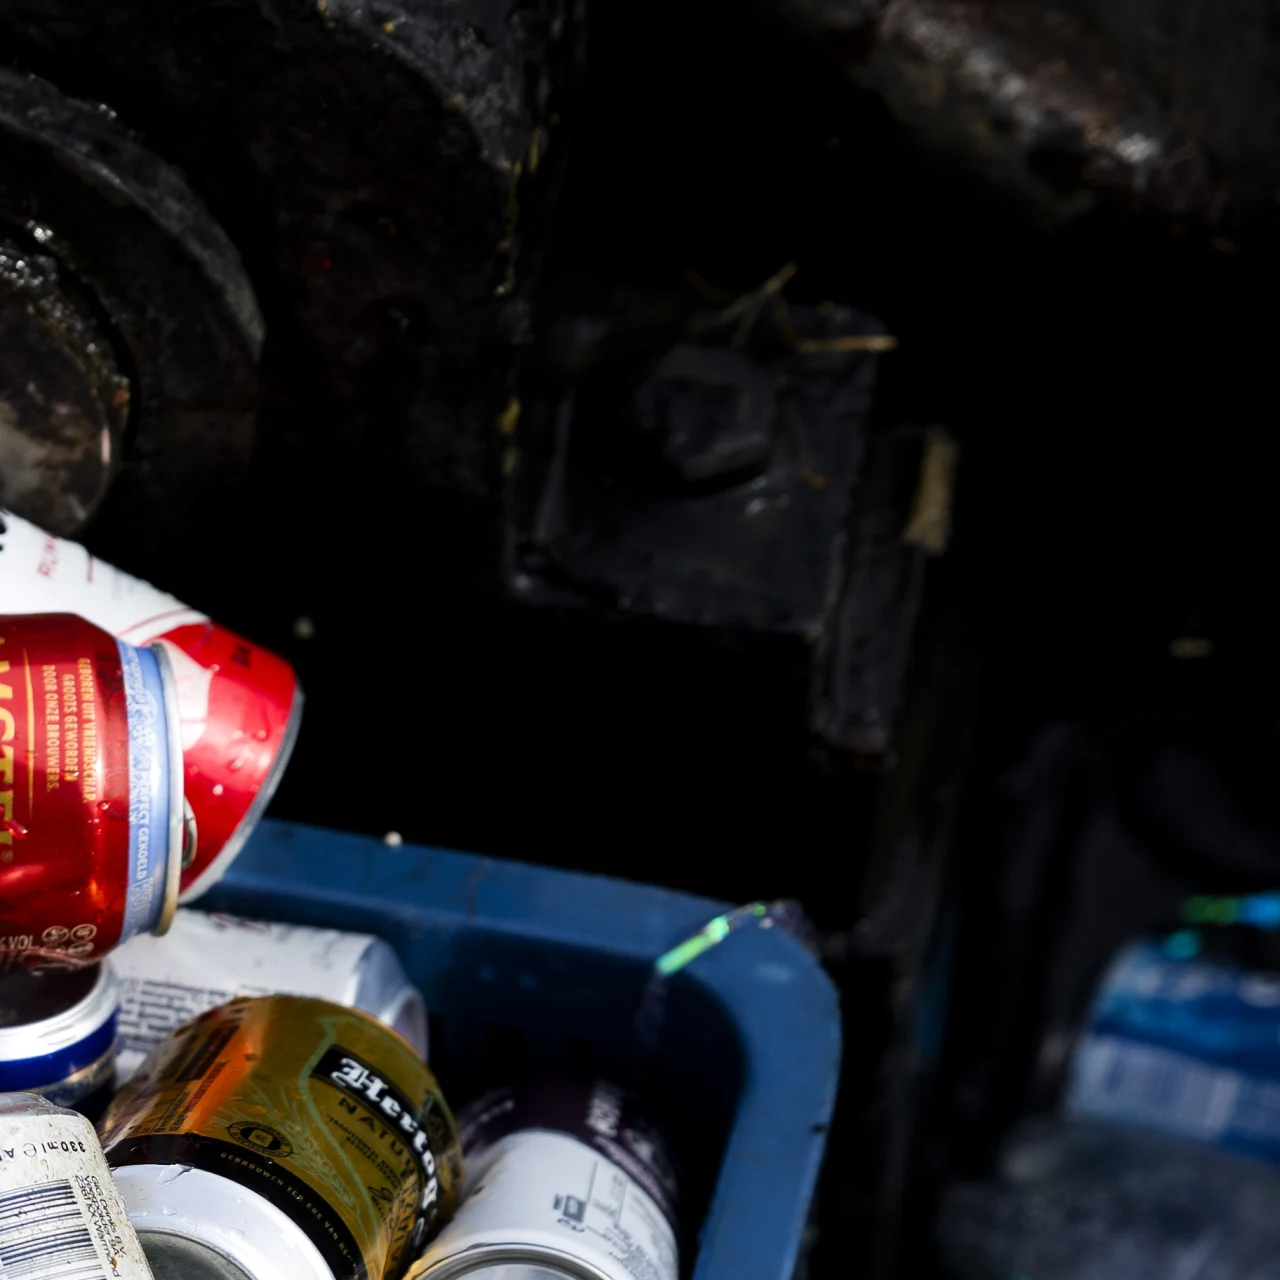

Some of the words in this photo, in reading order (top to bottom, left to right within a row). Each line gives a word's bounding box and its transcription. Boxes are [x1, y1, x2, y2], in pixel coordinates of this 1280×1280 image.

[43, 665, 57, 690] DOOR
[62, 674, 75, 712] GROOTS
[77, 657, 93, 701] GEBOREN
[44, 693, 57, 722] ONZE
[81, 703, 93, 720] UIT
[45, 725, 59, 791] BROUWERS.
[63, 716, 78, 780] GEWORDEN
[82, 723, 96, 803] VRIENDSCHAP.
[41, 1141, 86, 1152] 330ml
